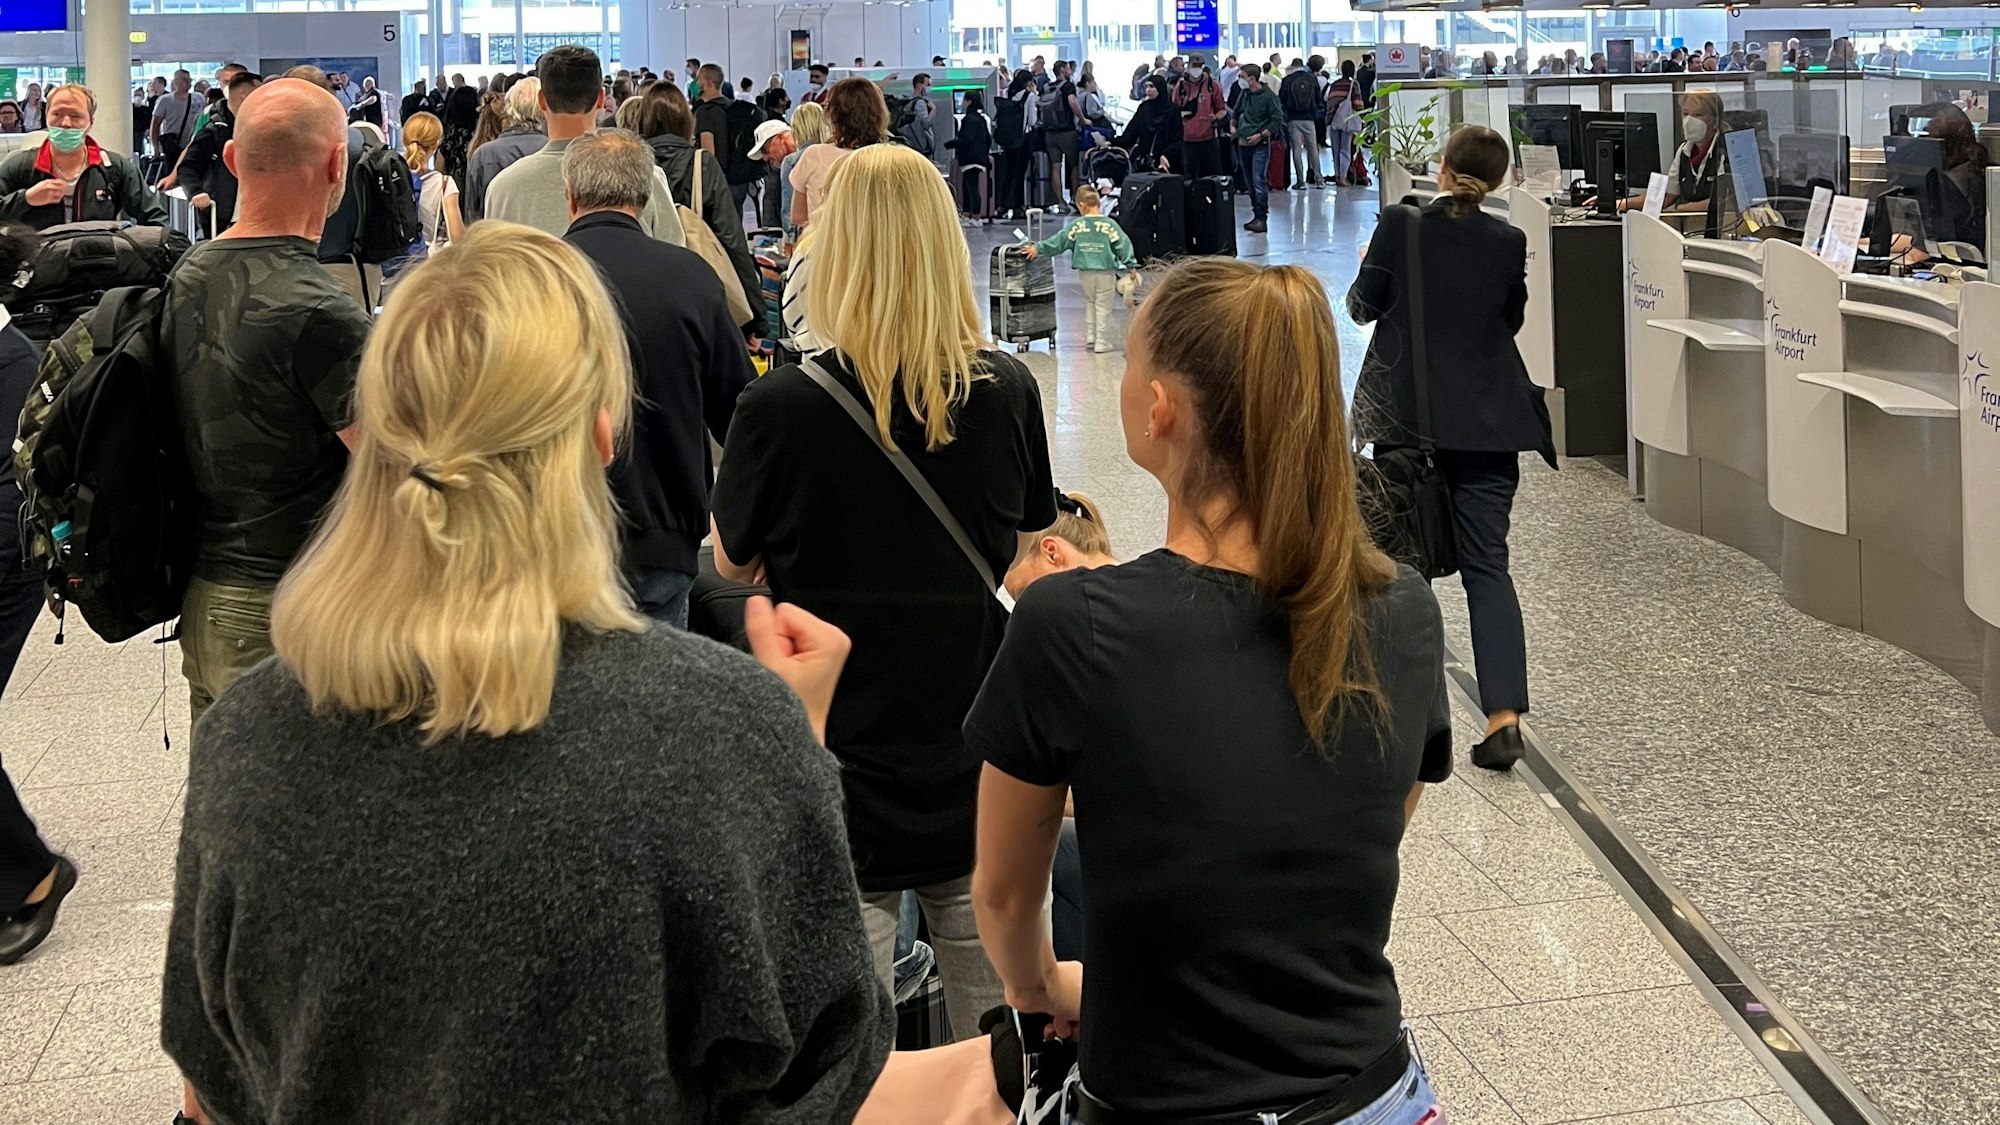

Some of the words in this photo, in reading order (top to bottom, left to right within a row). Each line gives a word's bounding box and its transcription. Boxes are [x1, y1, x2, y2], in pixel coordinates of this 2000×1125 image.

[384, 25, 395, 41] 5
[1775, 323, 1817, 346] Frankfurt
[1775, 340, 1804, 360] Airport
